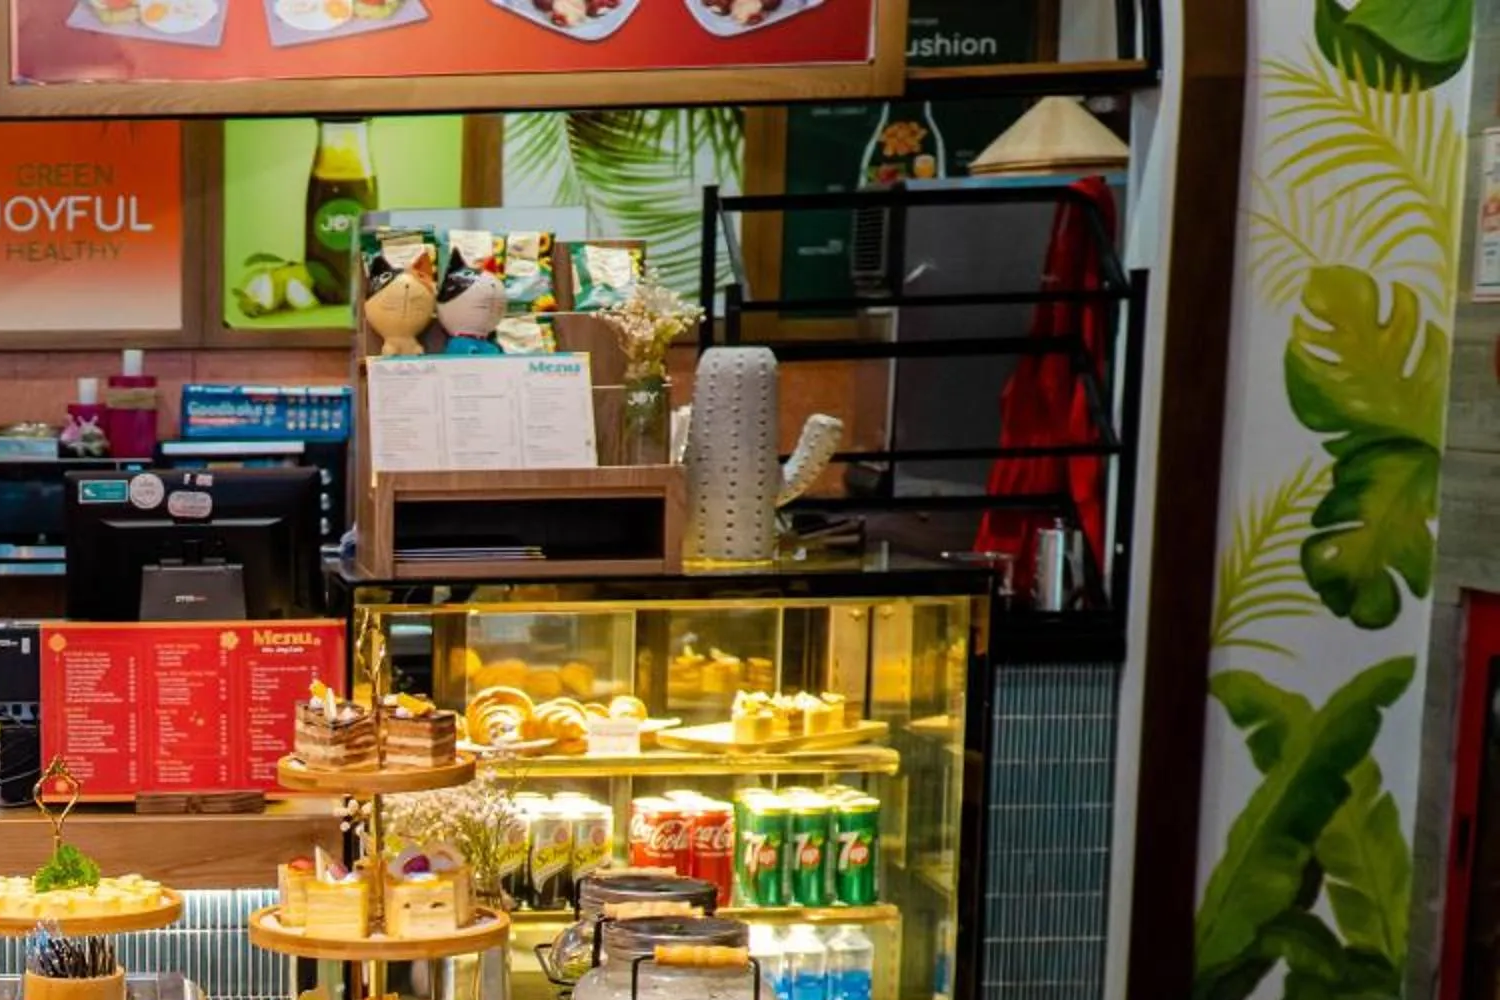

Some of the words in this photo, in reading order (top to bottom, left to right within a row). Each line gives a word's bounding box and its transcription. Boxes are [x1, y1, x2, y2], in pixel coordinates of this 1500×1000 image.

[904, 32, 997, 57] ushion
[16, 162, 115, 188] GREEN
[5, 239, 124, 263] HEALTHY
[529, 361, 582, 374] Menu
[252, 629, 313, 647] Menu
